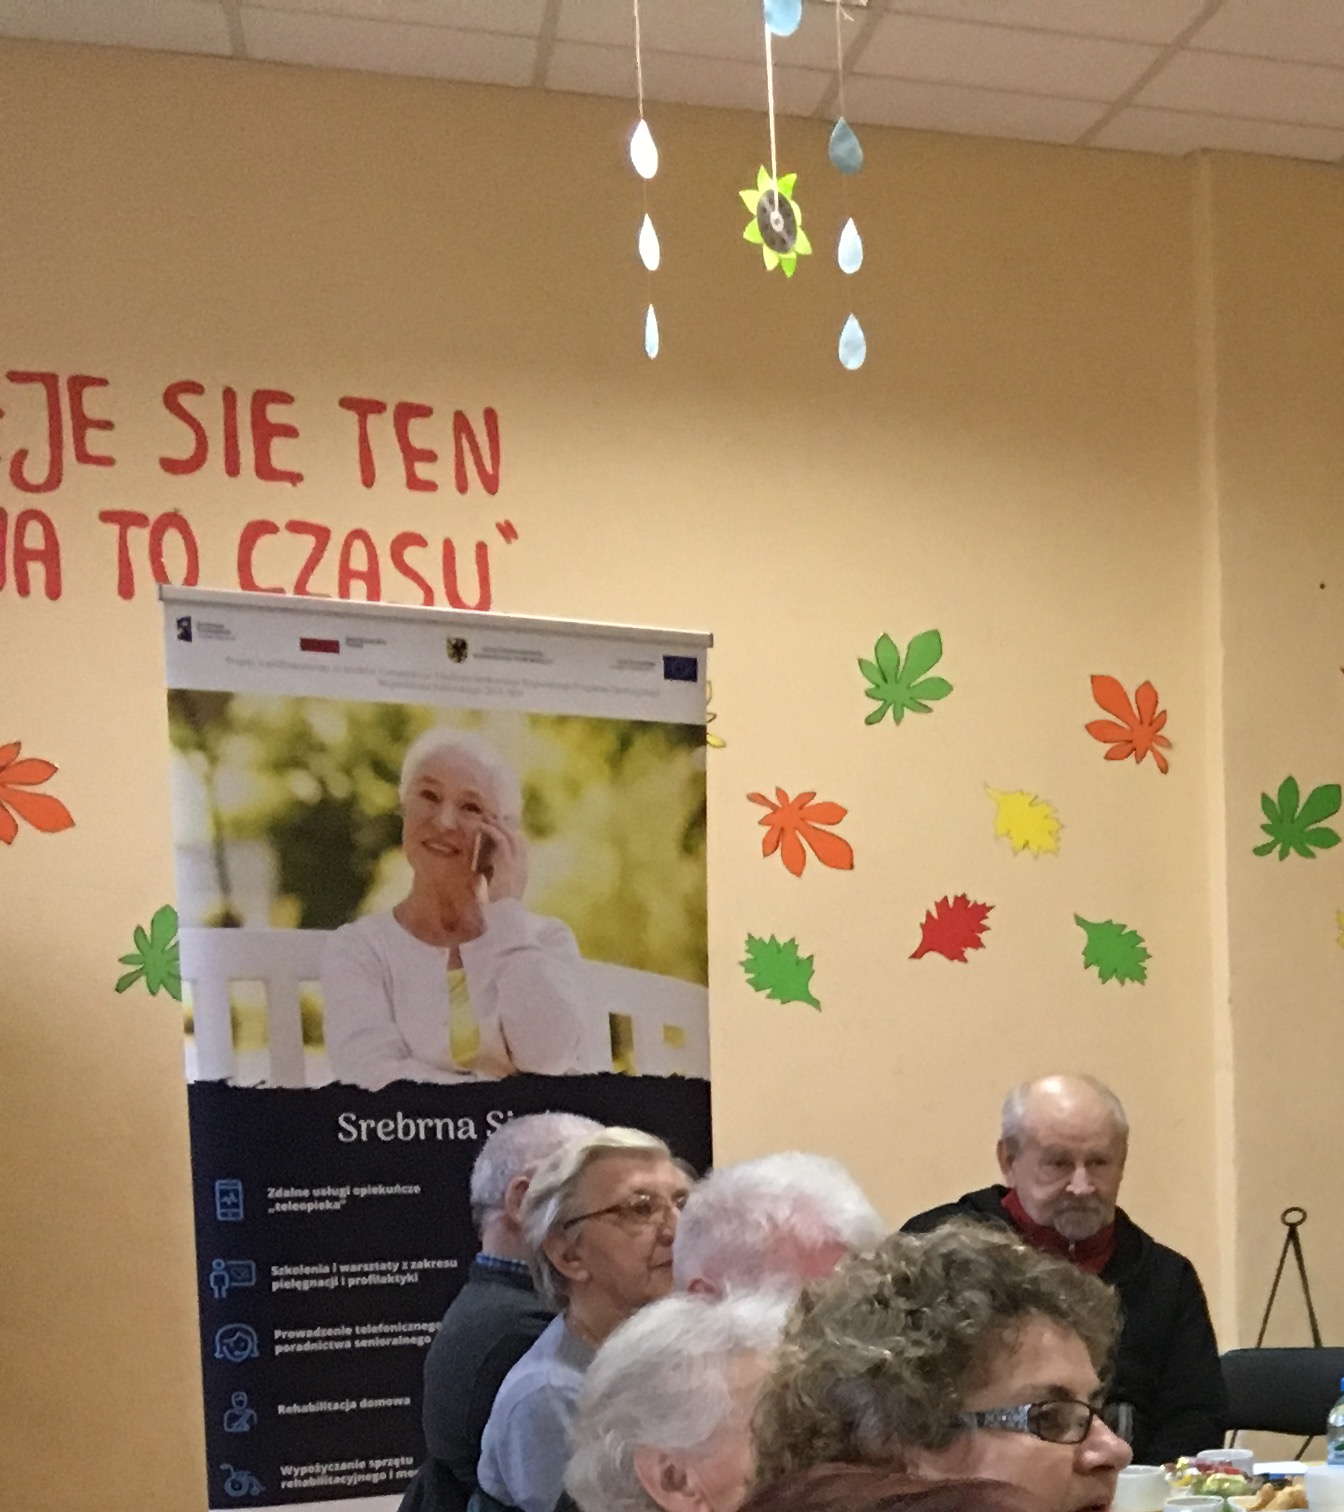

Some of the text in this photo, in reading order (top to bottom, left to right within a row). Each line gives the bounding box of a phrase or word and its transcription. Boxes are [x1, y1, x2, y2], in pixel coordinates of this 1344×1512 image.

[0, 371, 501, 496] JE SIE TEN
[99, 508, 200, 601] TO
[338, 1111, 477, 1143] Srebrna
[267, 1186, 310, 1198] Zdalne
[312, 1185, 350, 1198] usługi
[271, 1263, 330, 1276] Szkolenia
[339, 1261, 399, 1273] warsztaty
[410, 1258, 458, 1270] zakresu
[348, 1272, 419, 1288] profilaktyki
[274, 1326, 353, 1340] Prowadzenie
[274, 1334, 431, 1356] poradnictwa senioralnego
[277, 1397, 411, 1415] Rehabilitacja domowa
[280, 1459, 366, 1477] Wypożyczanie
[280, 1471, 387, 1489] rehabilitacyjnego
